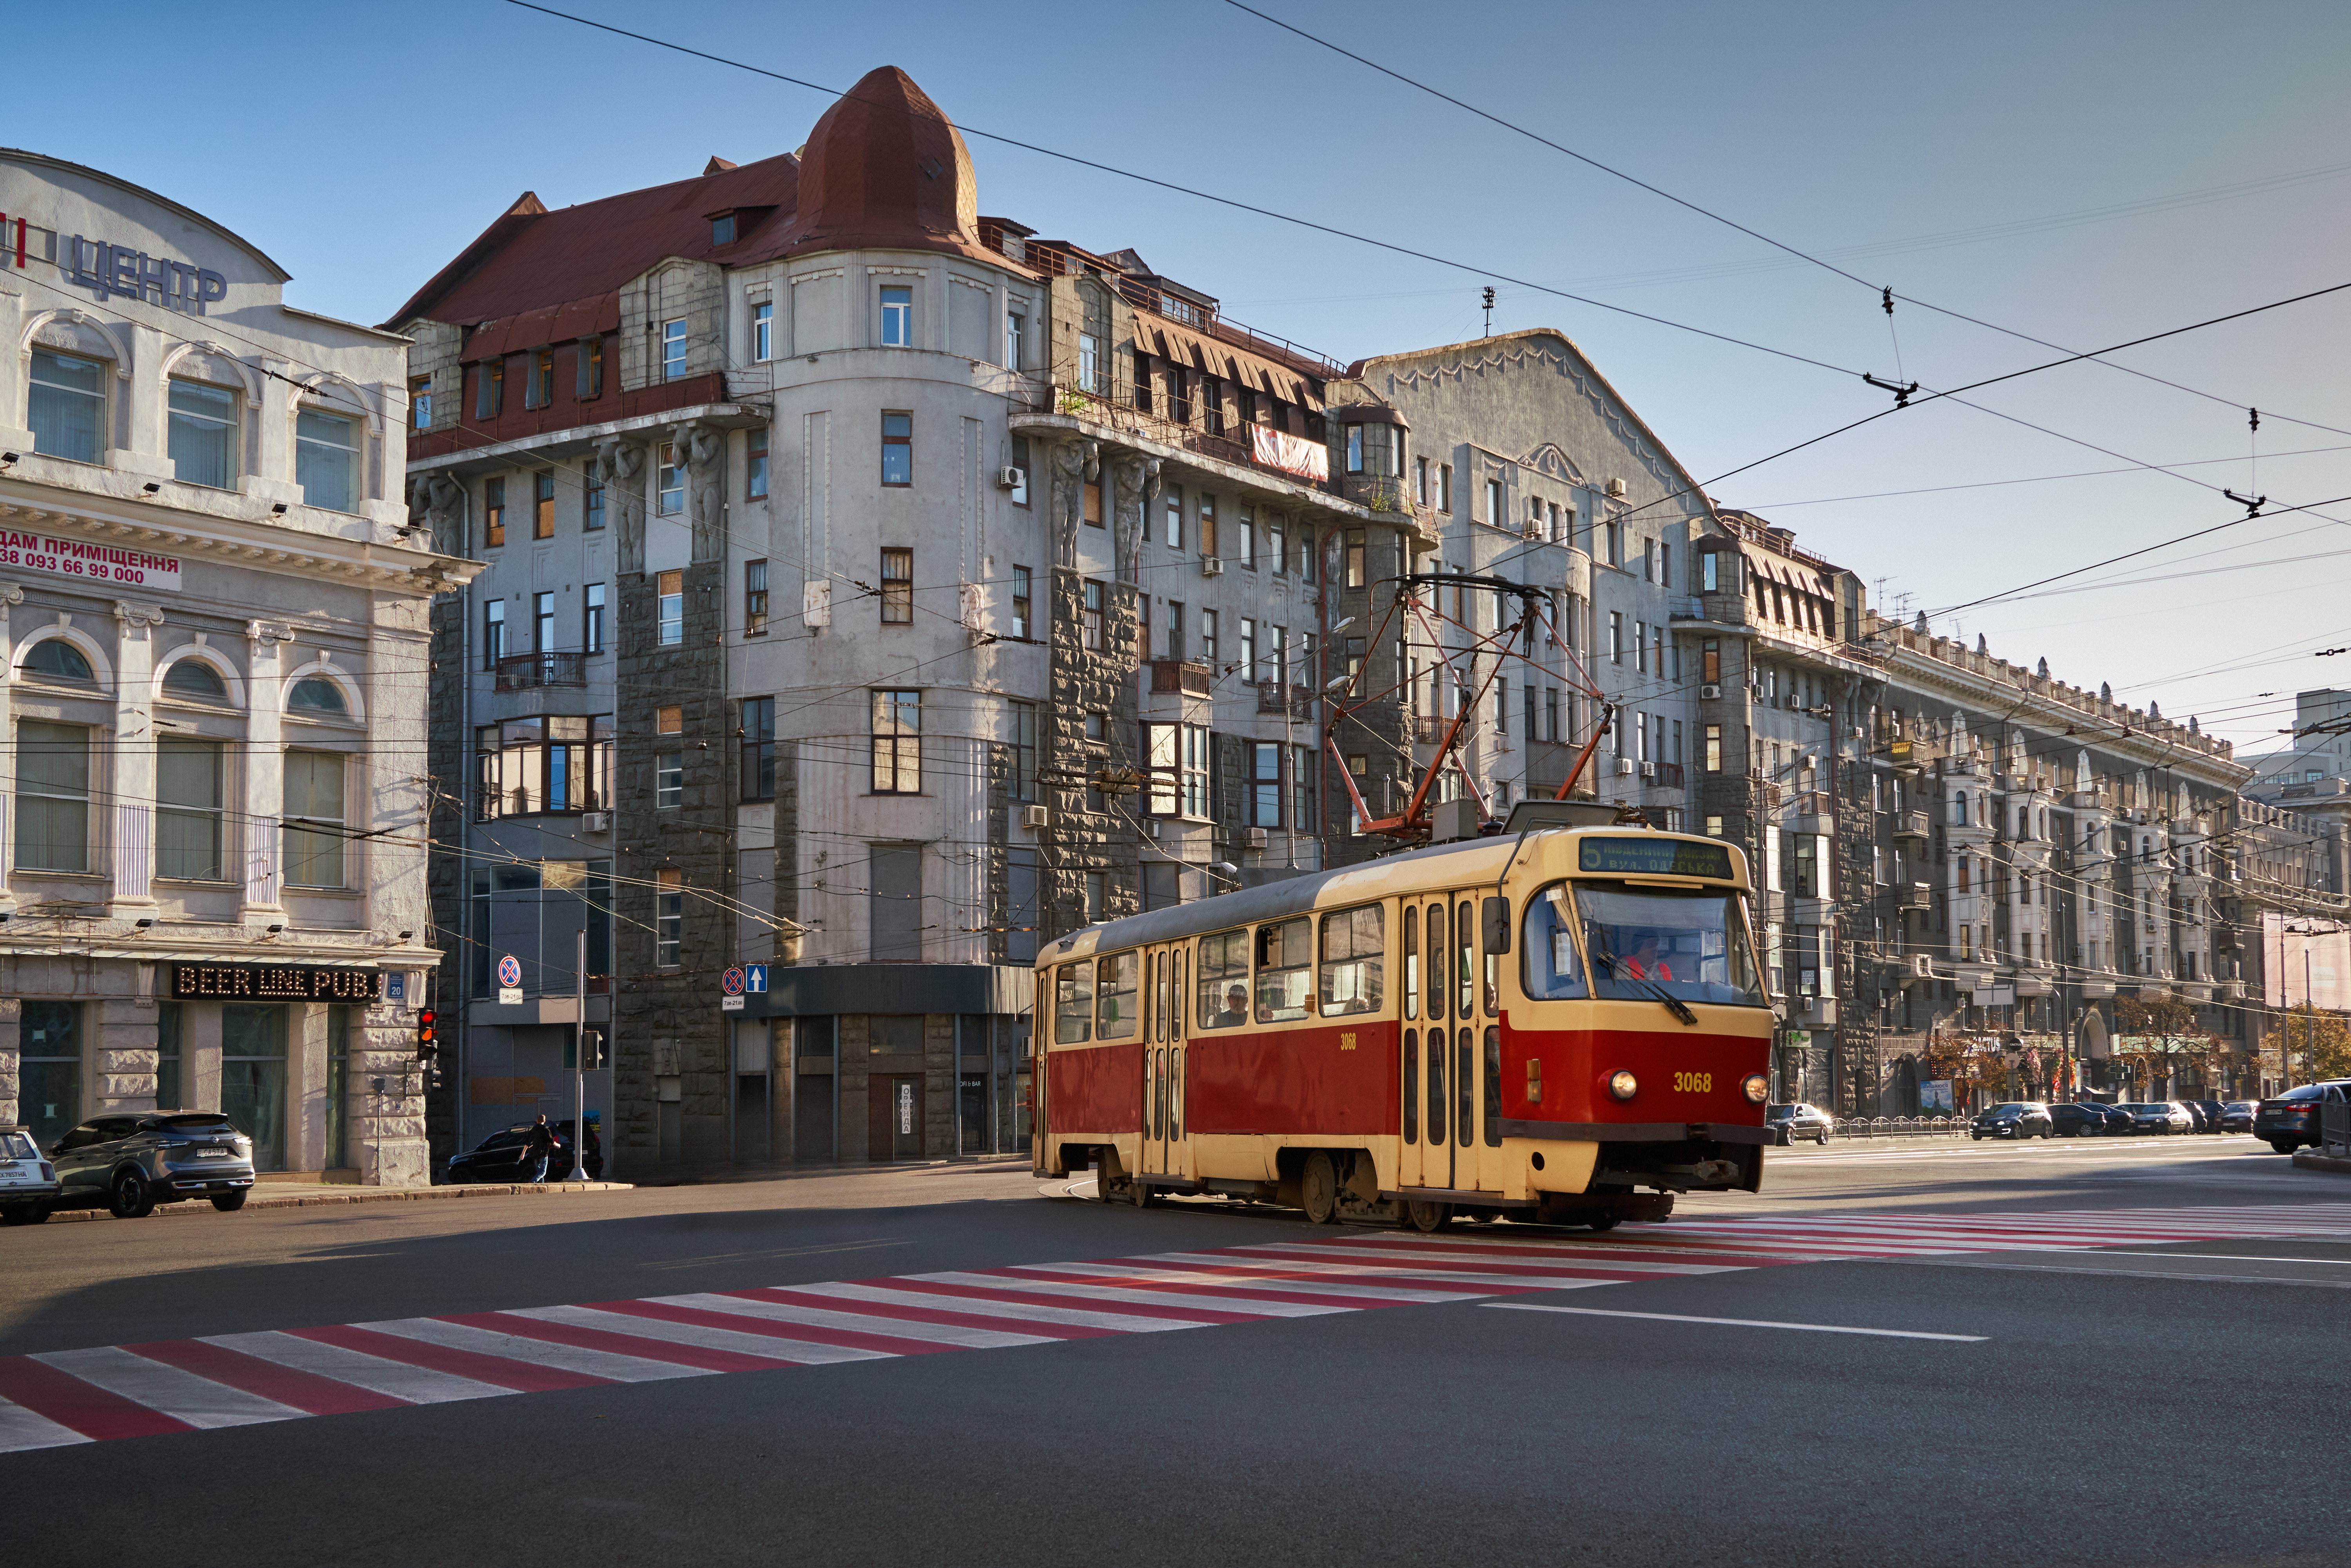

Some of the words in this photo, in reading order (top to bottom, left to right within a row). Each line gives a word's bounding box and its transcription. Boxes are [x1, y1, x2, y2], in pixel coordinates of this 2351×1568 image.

[73, 234, 227, 317] ЦЕНТР
[25, 553, 57, 570] 093
[63, 559, 83, 574] 66
[89, 563, 109, 578] 99
[114, 568, 144, 583] 000
[45, 538, 178, 573] ПРИМІЩЕННЯ
[1584, 842, 1601, 868] 5
[1649, 860, 1715, 874] ОДЕСЬКА
[179, 966, 251, 995] BEER
[259, 969, 306, 990] LINE
[314, 972, 368, 998] PUB
[392, 987, 401, 995] 20
[1340, 1032, 1356, 1050] 3068
[1674, 1072, 1712, 1093] 3068
